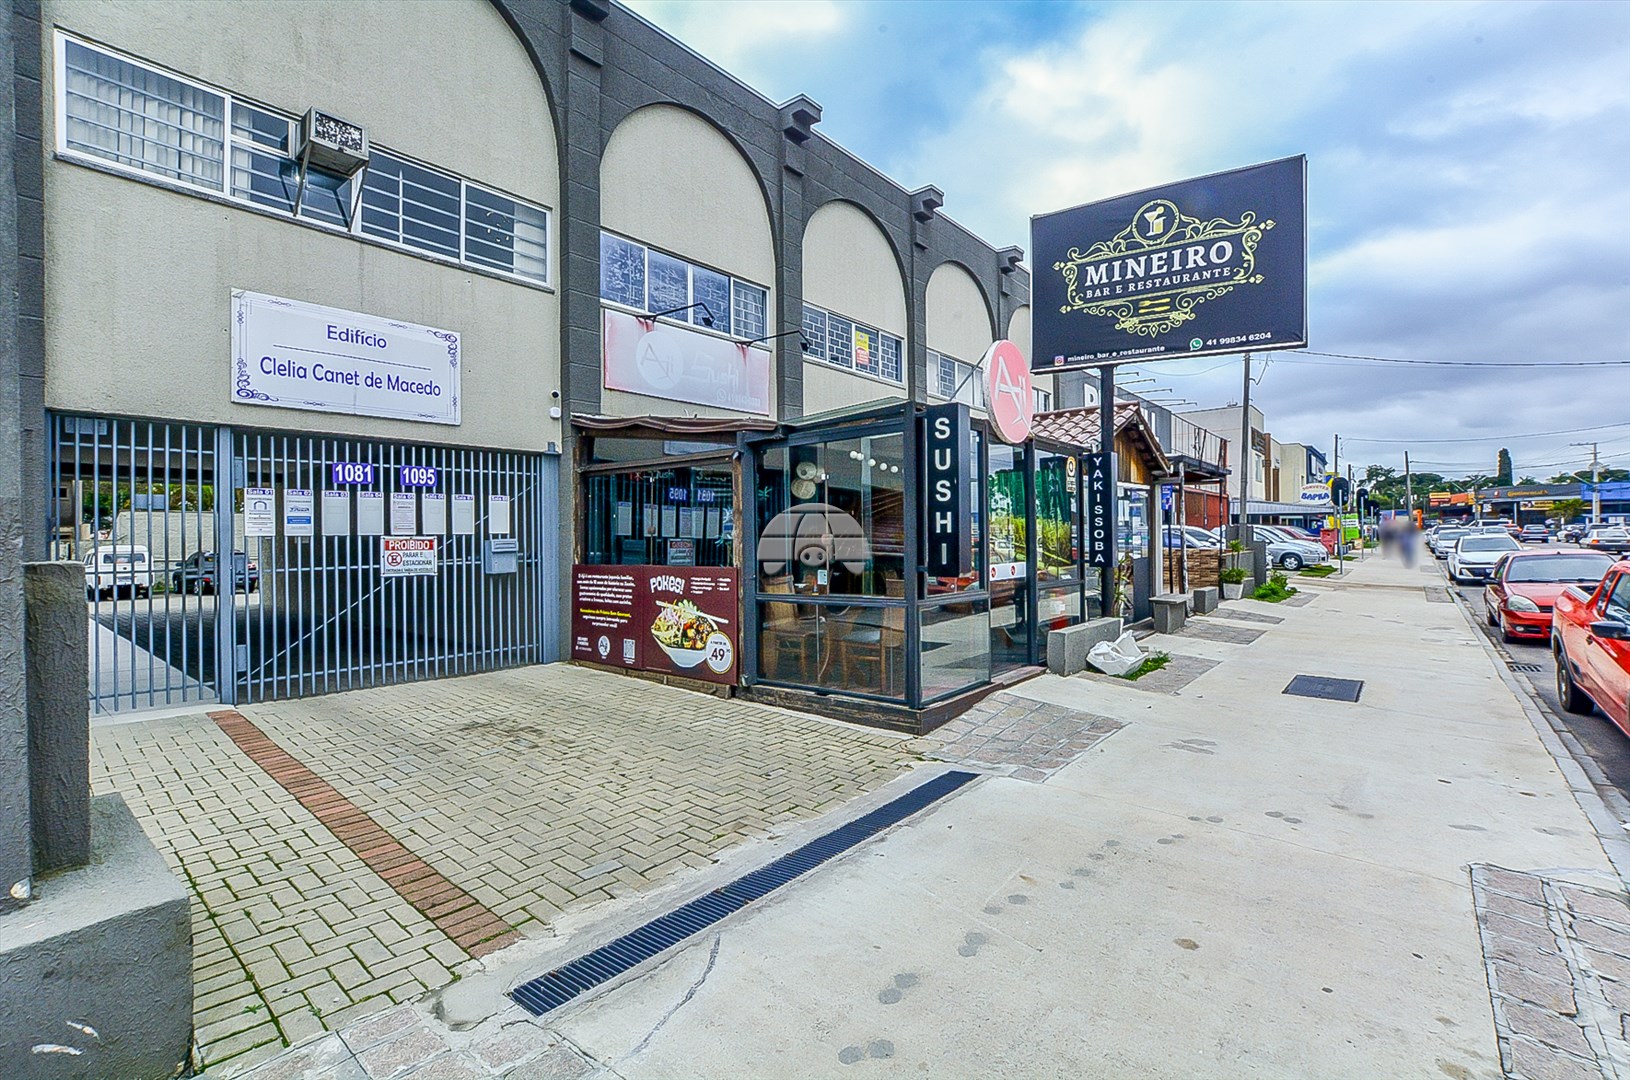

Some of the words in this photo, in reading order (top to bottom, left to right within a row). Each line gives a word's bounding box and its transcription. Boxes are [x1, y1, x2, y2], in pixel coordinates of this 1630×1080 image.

[1084, 240, 1233, 287] MINEIRO
[1086, 287, 1111, 299] BAR
[1116, 285, 1124, 294] E
[1128, 266, 1232, 292] RESTAURANTE
[327, 324, 388, 349] Edifício
[1206, 338, 1218, 346] 41
[1219, 335, 1247, 345] 99834
[1248, 331, 1272, 341] 6204
[1067, 344, 1166, 363] mineiro_bar_e_restaurante
[259, 356, 307, 380] Clelia
[312, 363, 360, 386] Canet
[364, 371, 383, 389] de
[387, 374, 442, 397] Macedo
[335, 464, 372, 482] 1081
[403, 467, 436, 484] 1095
[934, 417, 952, 565] SUSHI
[1093, 456, 1105, 563] YAKISSOBA
[388, 540, 430, 550] PROIBIDO
[711, 647, 725, 661] 49
